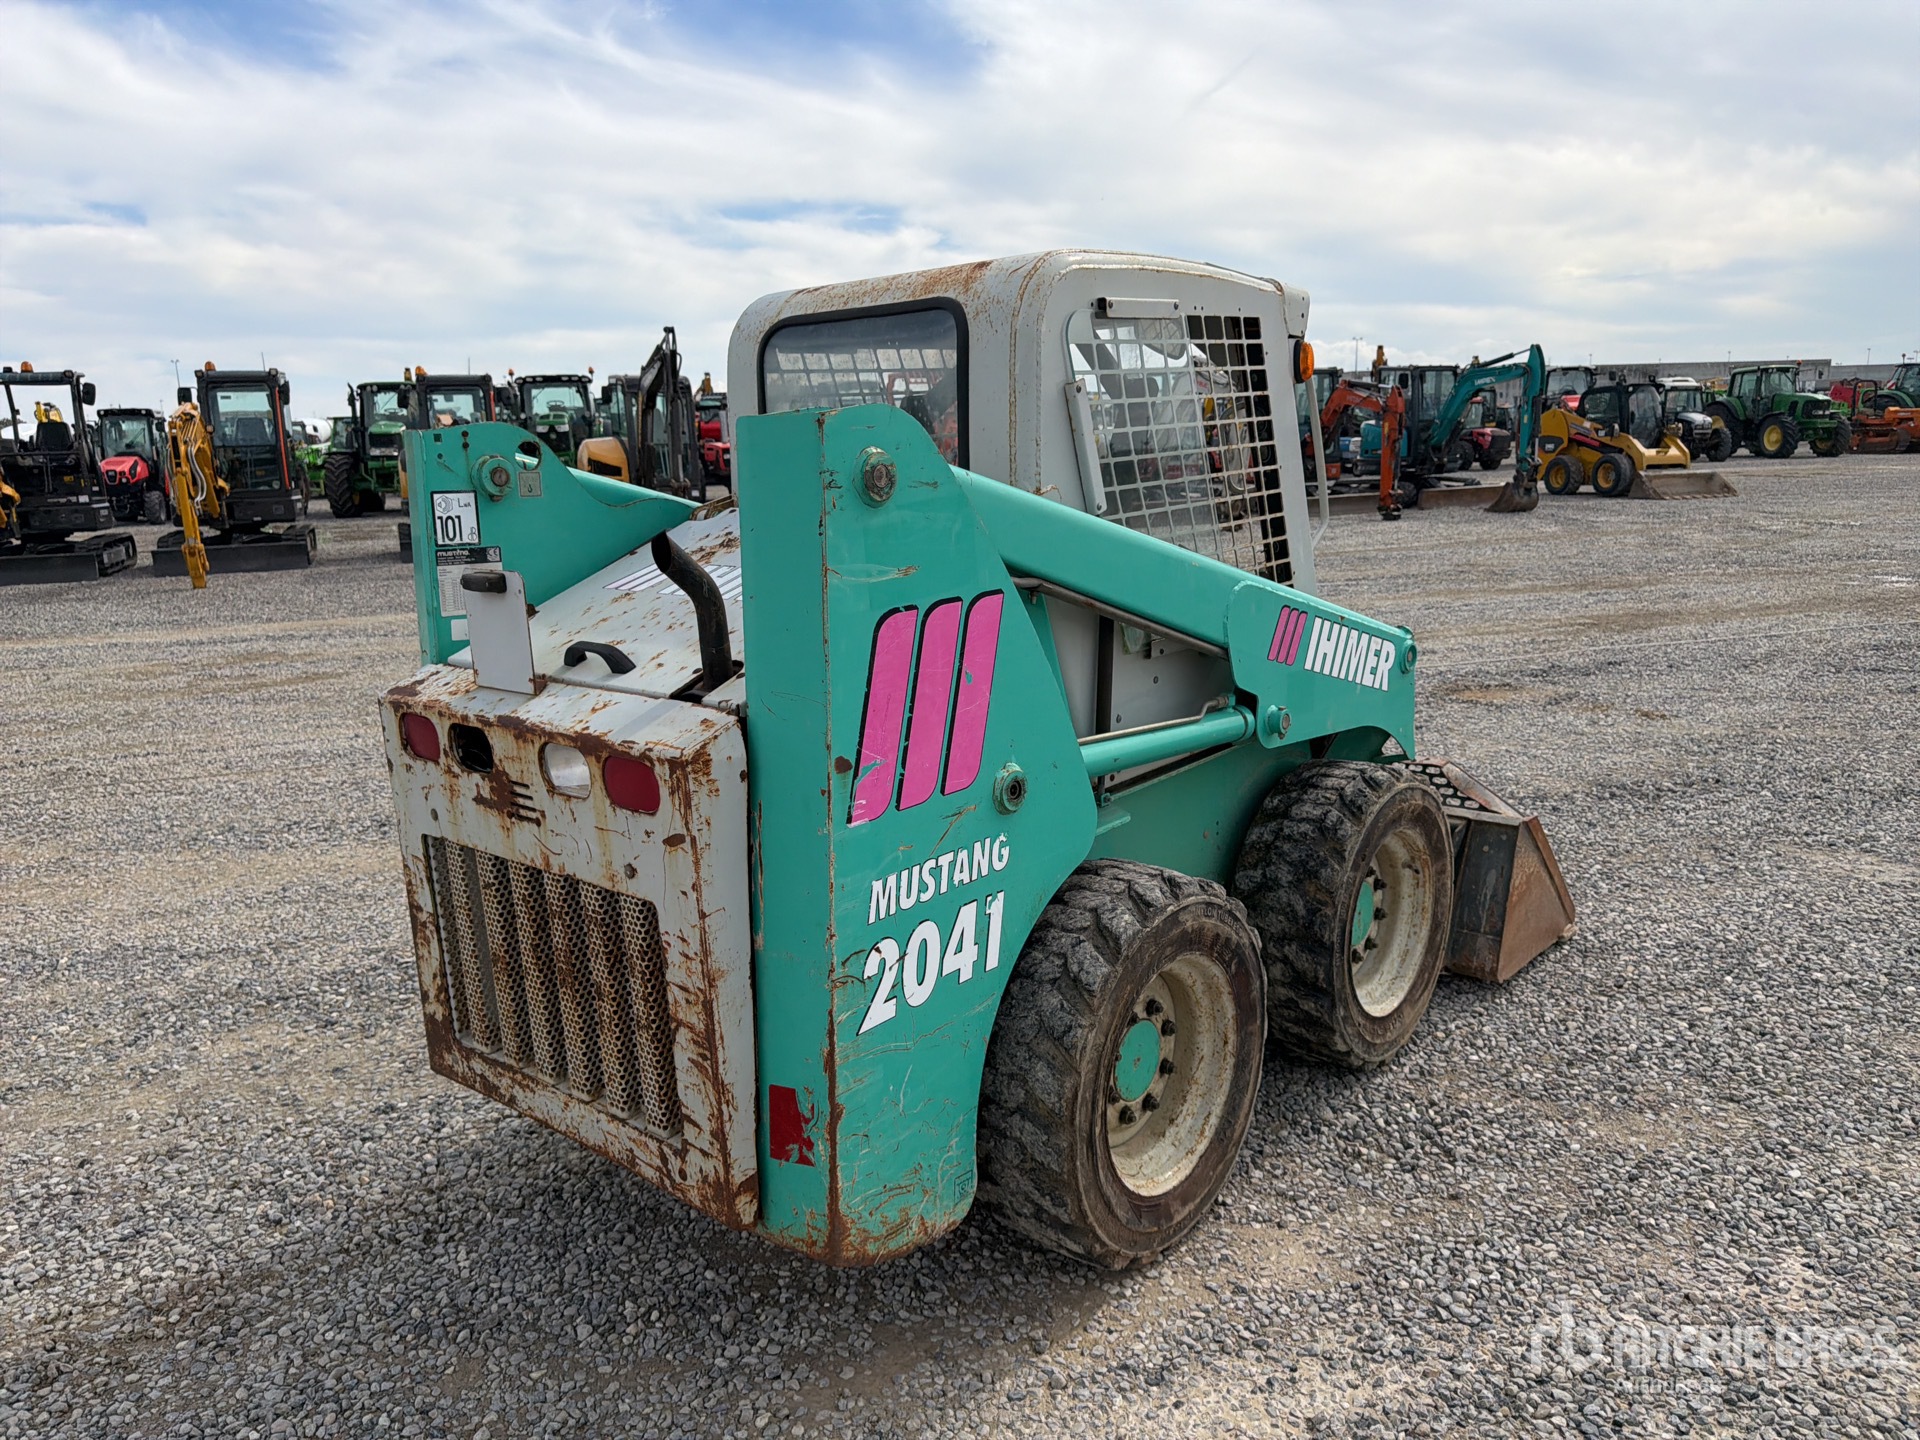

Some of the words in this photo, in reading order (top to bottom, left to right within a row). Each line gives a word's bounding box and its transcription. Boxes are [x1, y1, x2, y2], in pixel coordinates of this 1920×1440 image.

[437, 515, 463, 542] 101
[1304, 615, 1396, 692] IHIMER
[867, 833, 1010, 925] MUSTANG
[856, 890, 1005, 1036] 2041
